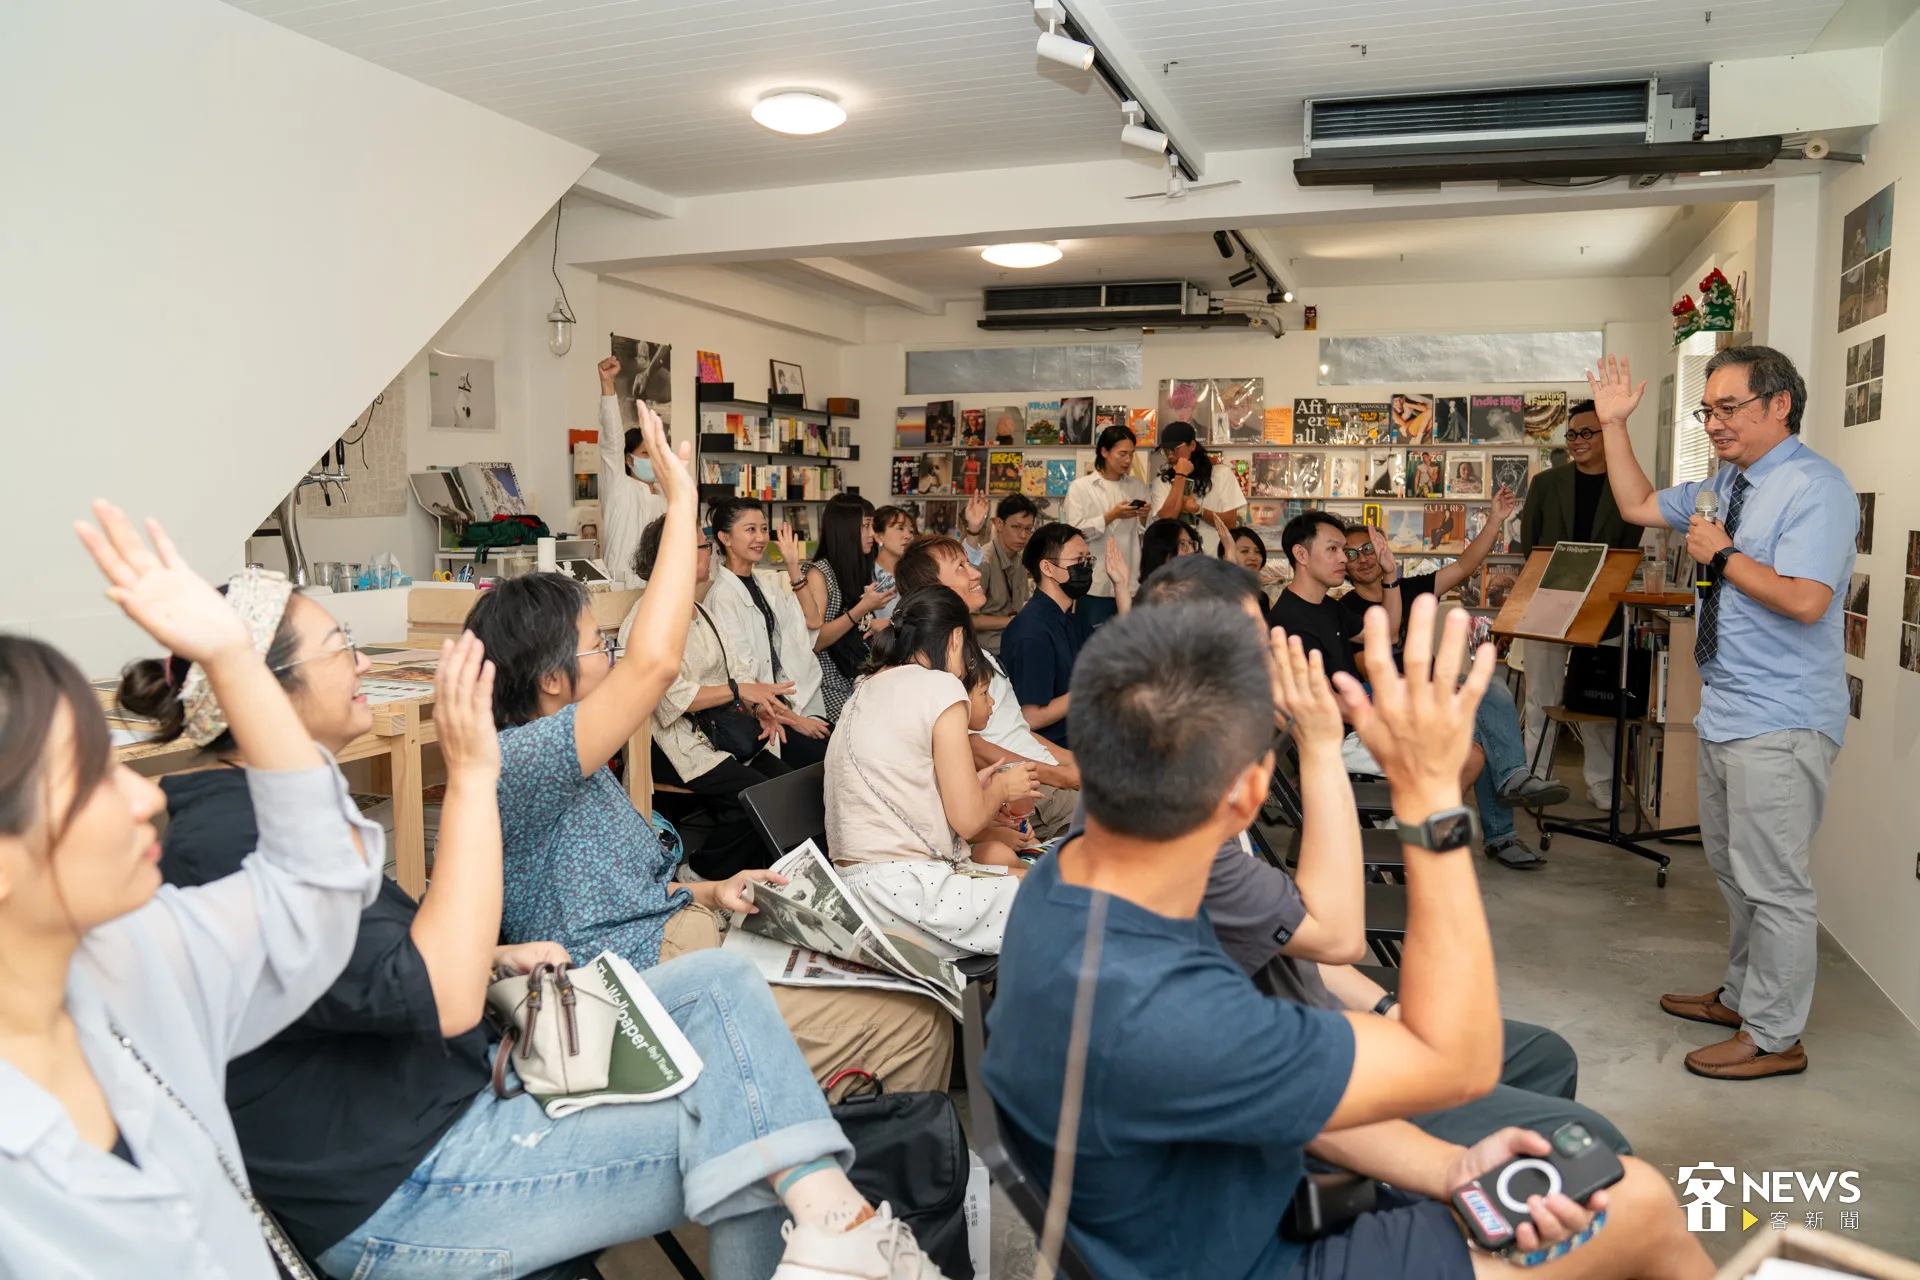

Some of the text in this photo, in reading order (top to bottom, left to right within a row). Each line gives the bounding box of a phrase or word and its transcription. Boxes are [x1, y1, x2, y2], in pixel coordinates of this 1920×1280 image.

[1295, 399, 1323, 414] Aft
[1295, 428, 1316, 444] all
[1408, 451, 1444, 461] frize
